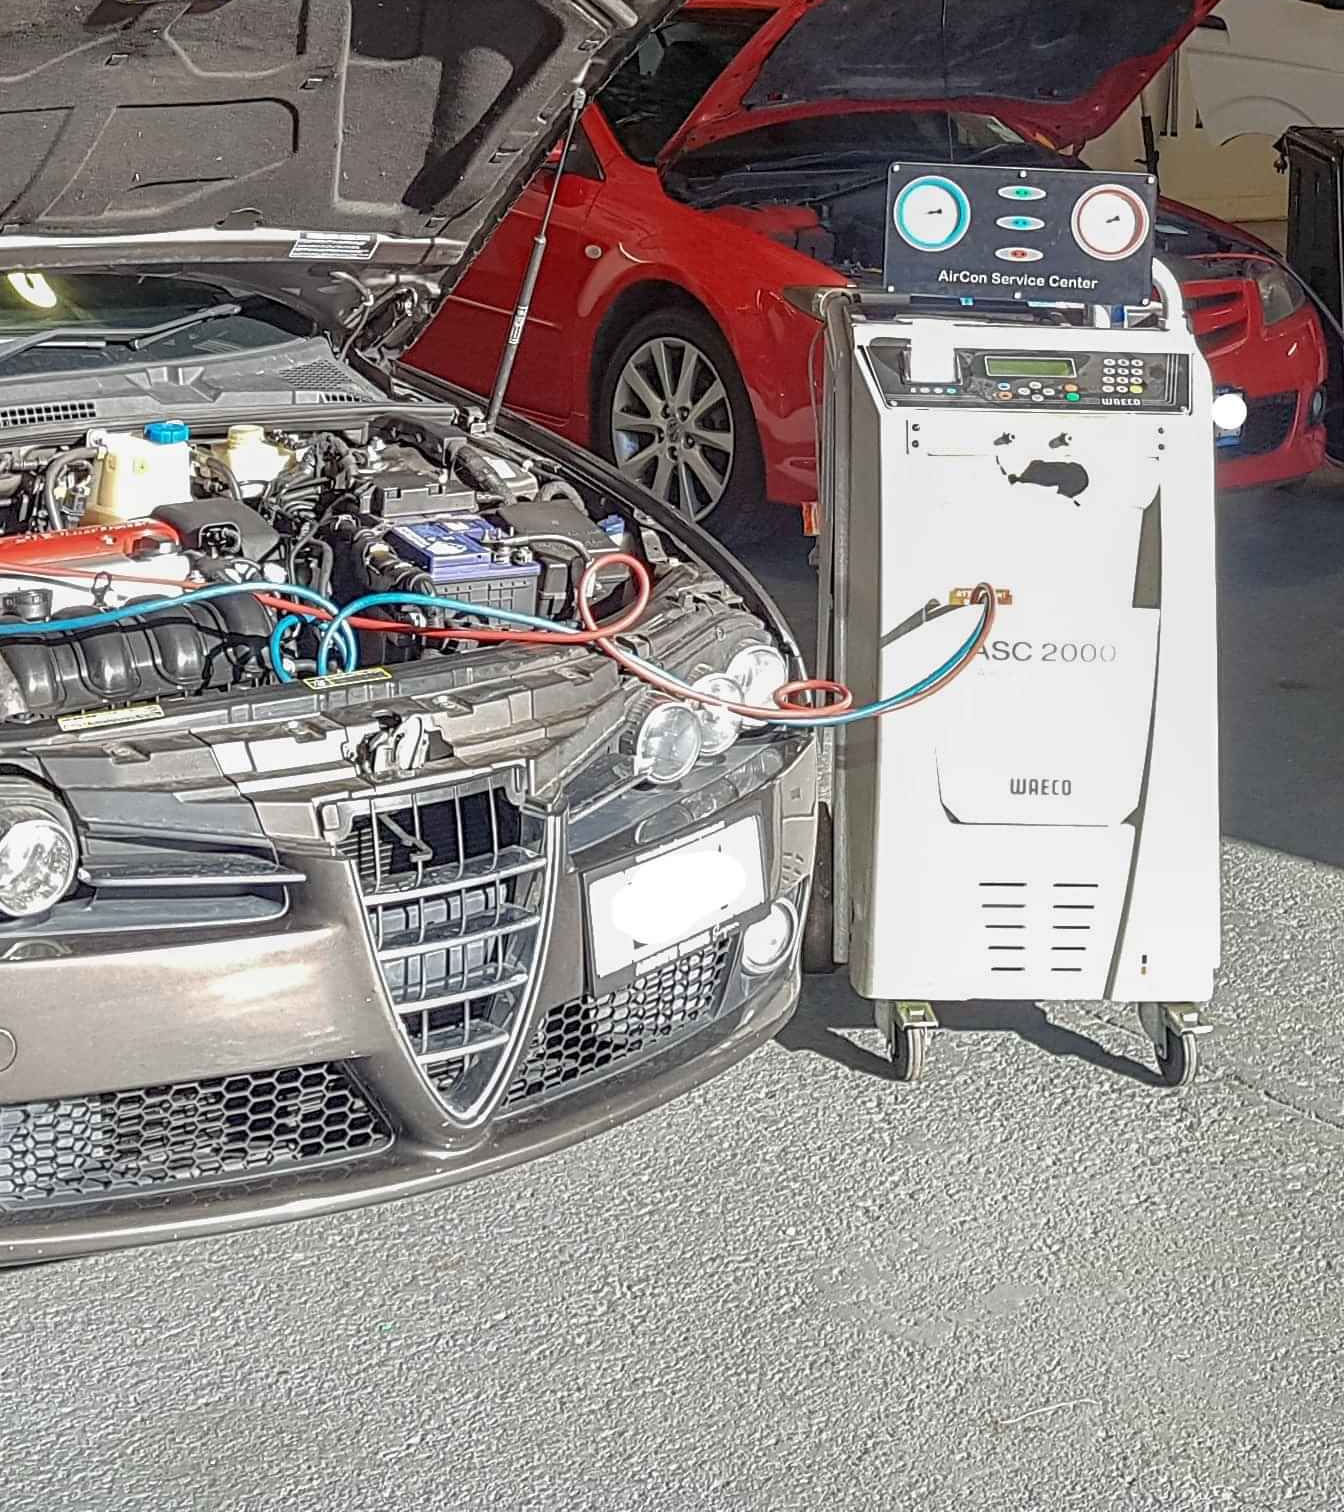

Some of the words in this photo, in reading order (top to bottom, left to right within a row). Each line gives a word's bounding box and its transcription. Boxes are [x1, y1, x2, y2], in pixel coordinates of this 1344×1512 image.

[937, 270, 988, 284] AirCon
[991, 272, 1045, 287] Service
[1049, 275, 1099, 289] Center
[1041, 642, 1117, 663] 2000
[1010, 778, 1072, 797] WAECO
